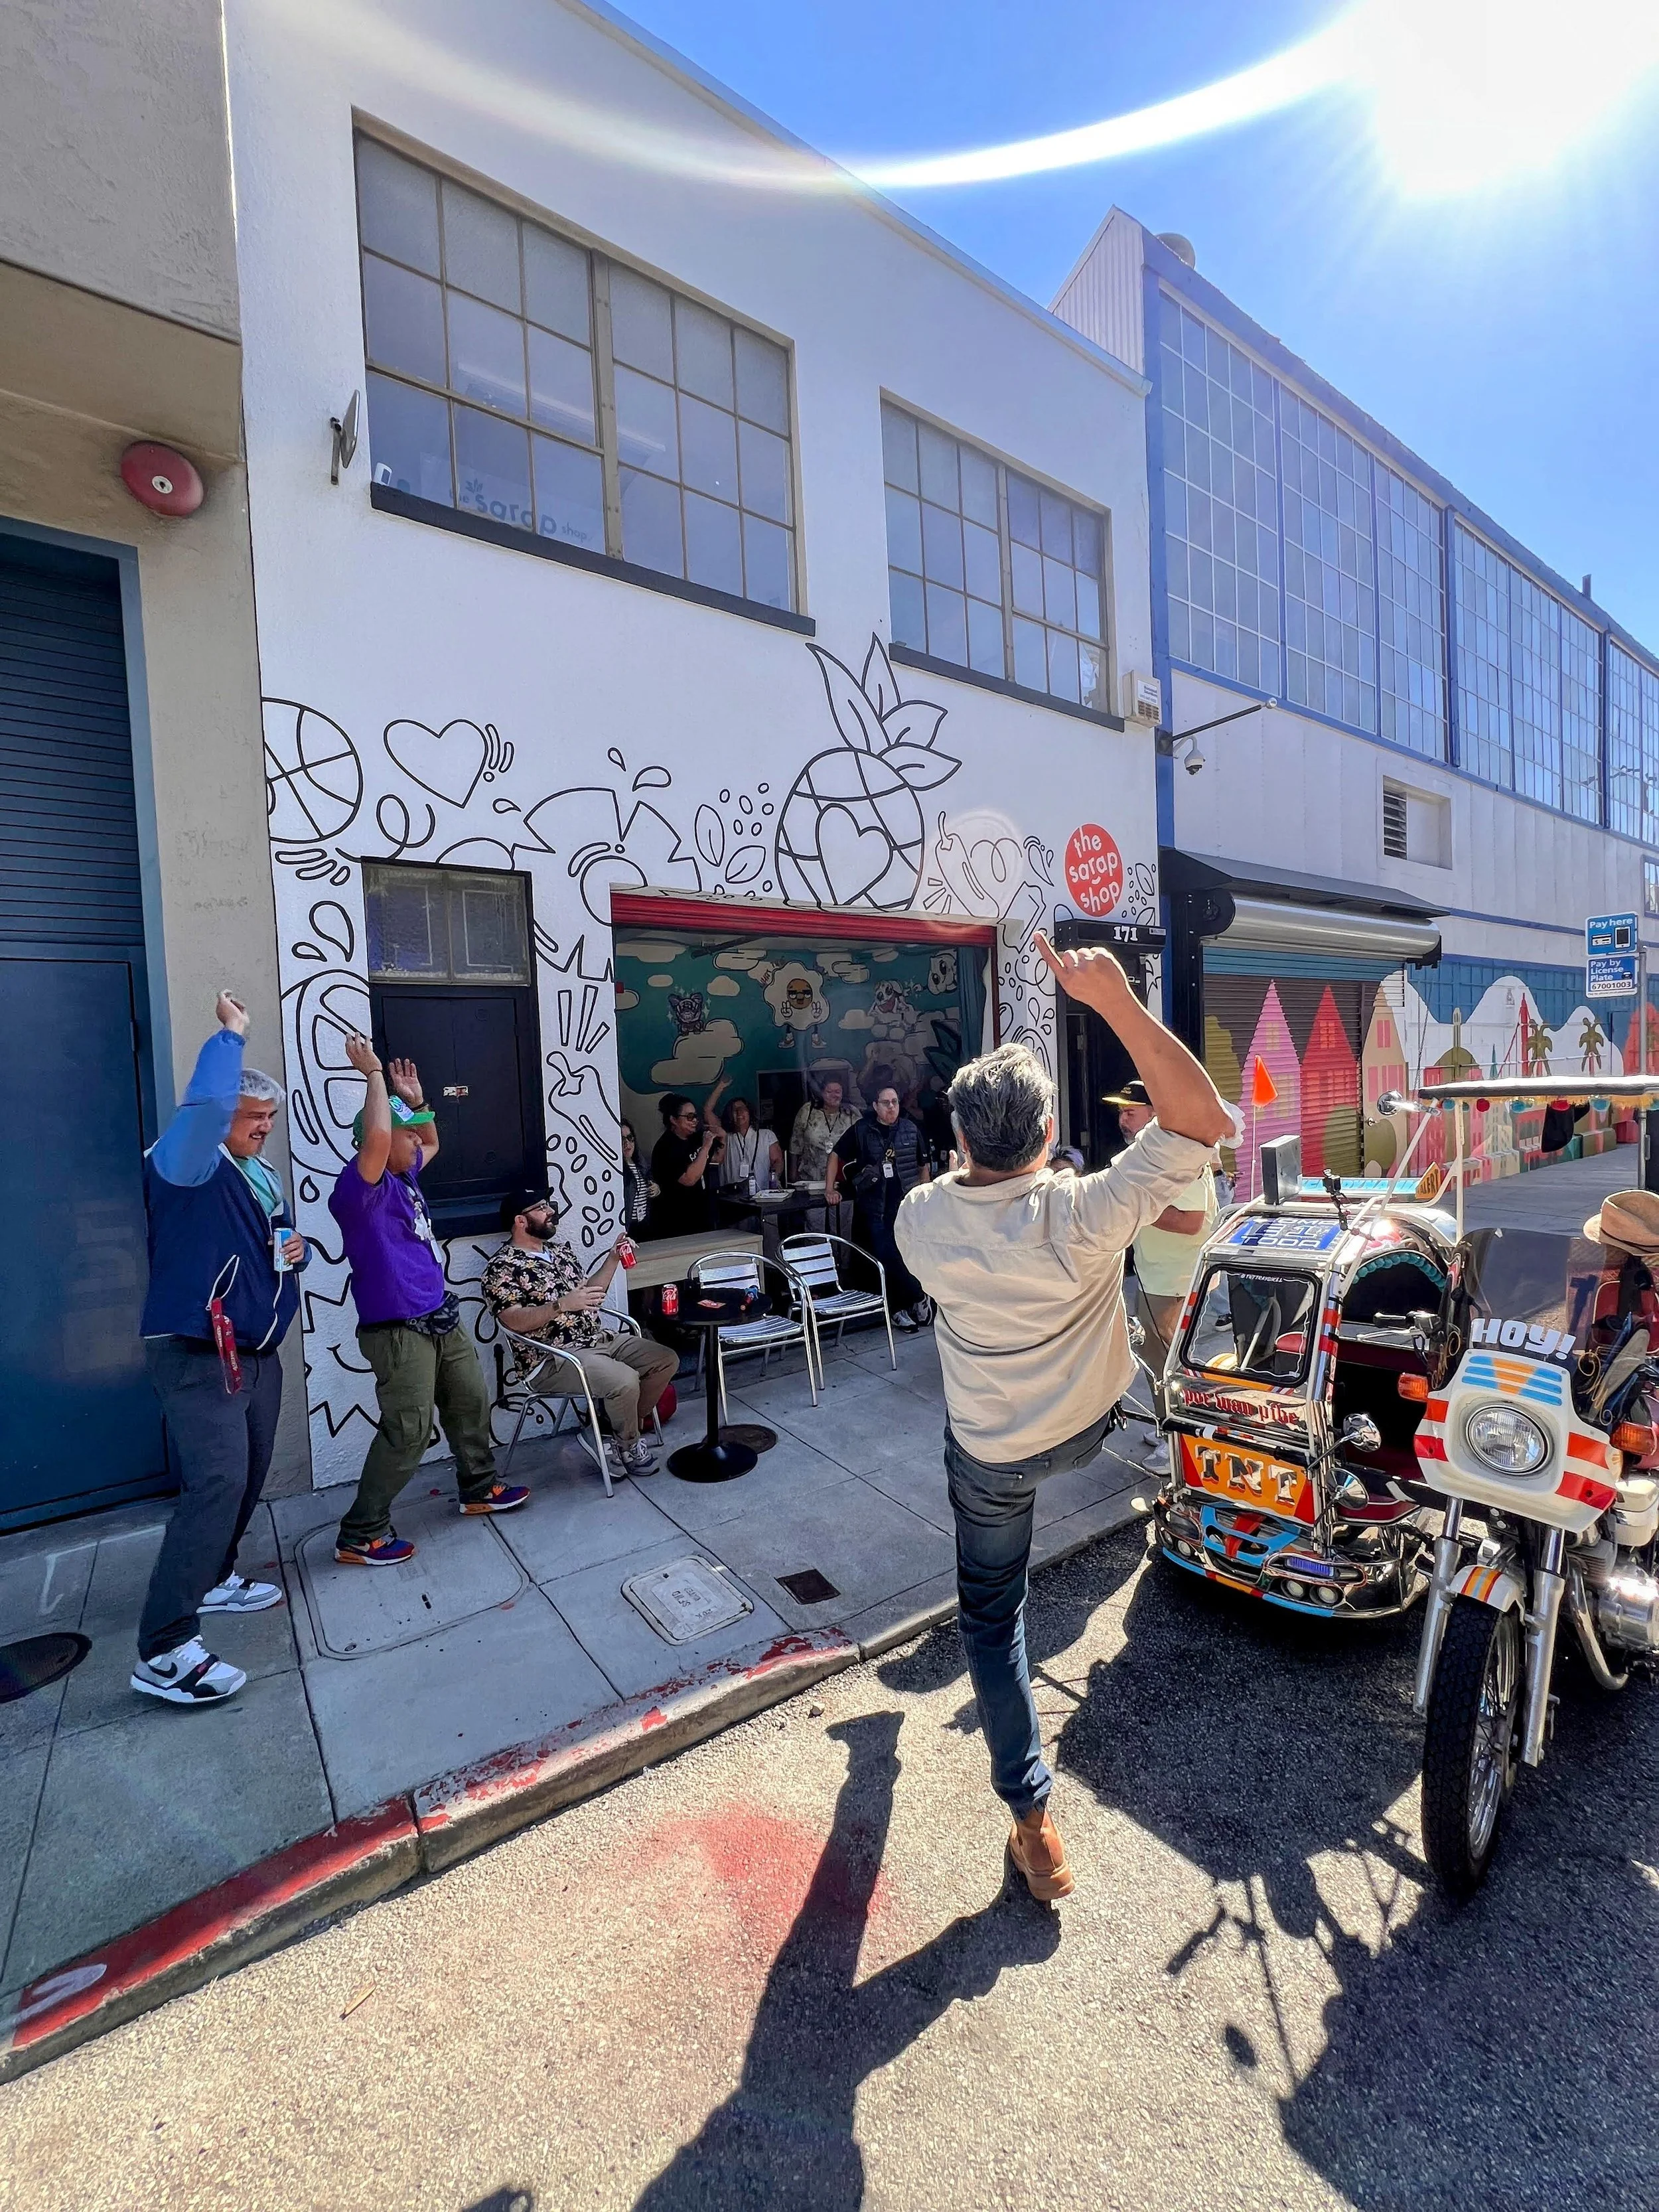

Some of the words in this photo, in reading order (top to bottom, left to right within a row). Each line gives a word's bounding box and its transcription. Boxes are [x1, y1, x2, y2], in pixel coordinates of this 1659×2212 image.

[1074, 826, 1102, 858] the
[1068, 851, 1118, 883] sarap
[1080, 881, 1119, 913] shop
[1113, 926, 1138, 942] 171
[1609, 918, 1633, 926] here
[1591, 966, 1624, 975] License
[1241, 1236, 1321, 1248] TODA
[1471, 1317, 1577, 1360] HOY!
[1195, 1444, 1297, 1507] TNT
